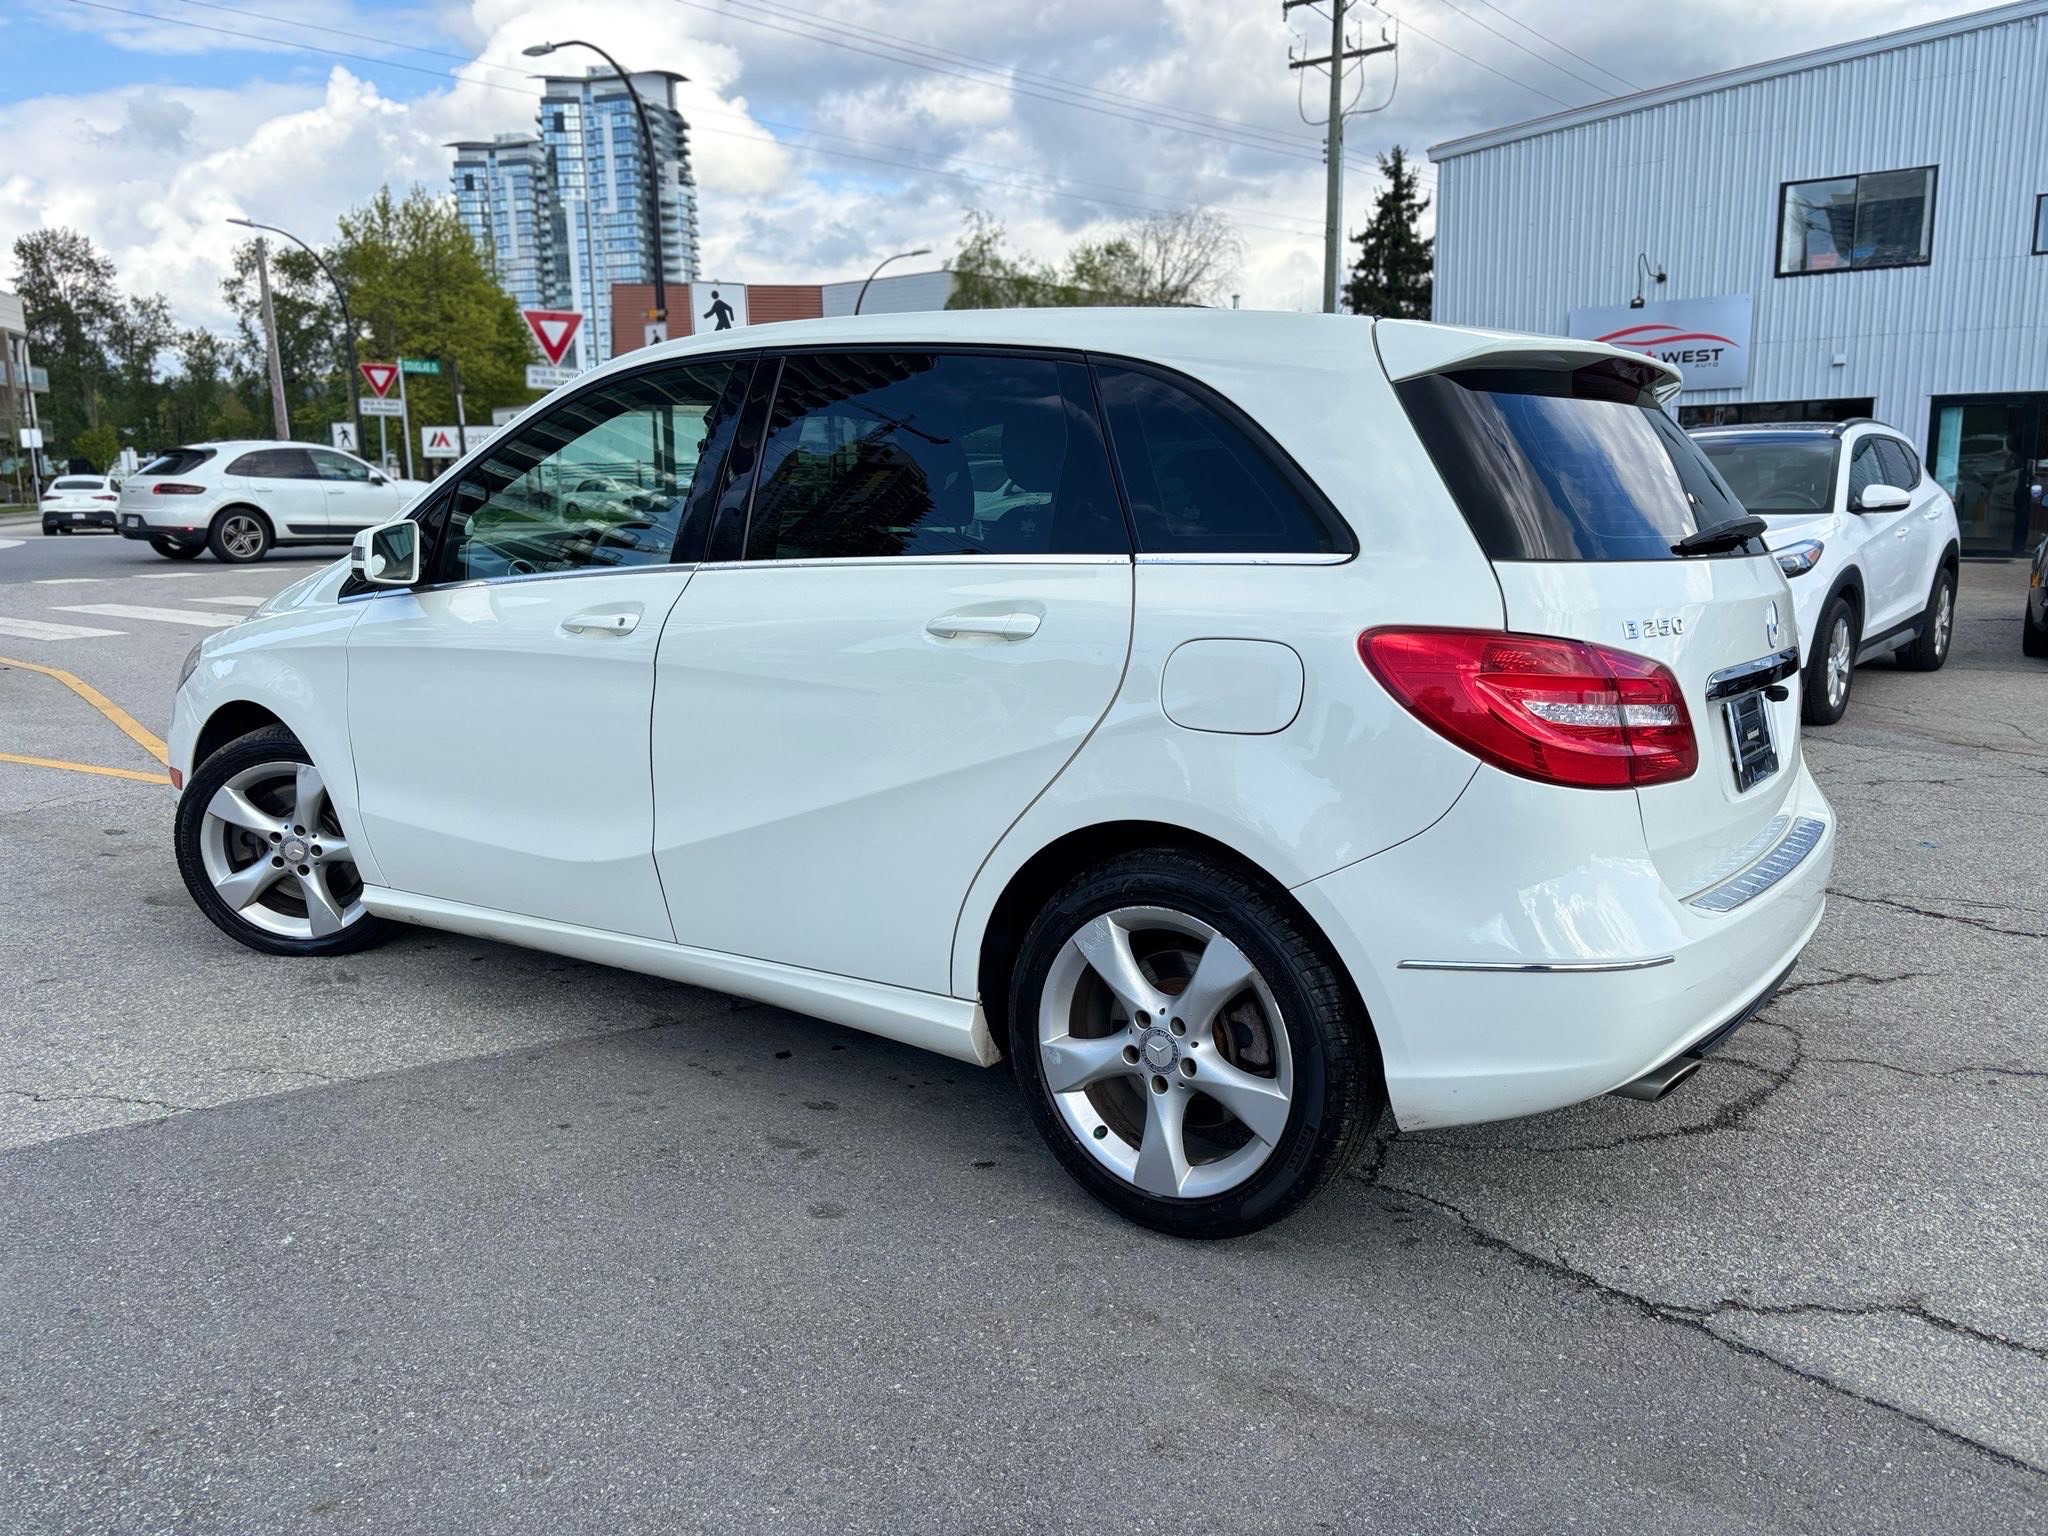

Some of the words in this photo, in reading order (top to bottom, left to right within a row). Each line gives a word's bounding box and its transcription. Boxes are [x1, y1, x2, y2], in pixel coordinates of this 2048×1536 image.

[1662, 348, 1725, 363] WEST
[1622, 620, 1639, 640] B
[1643, 616, 1685, 638] 250
